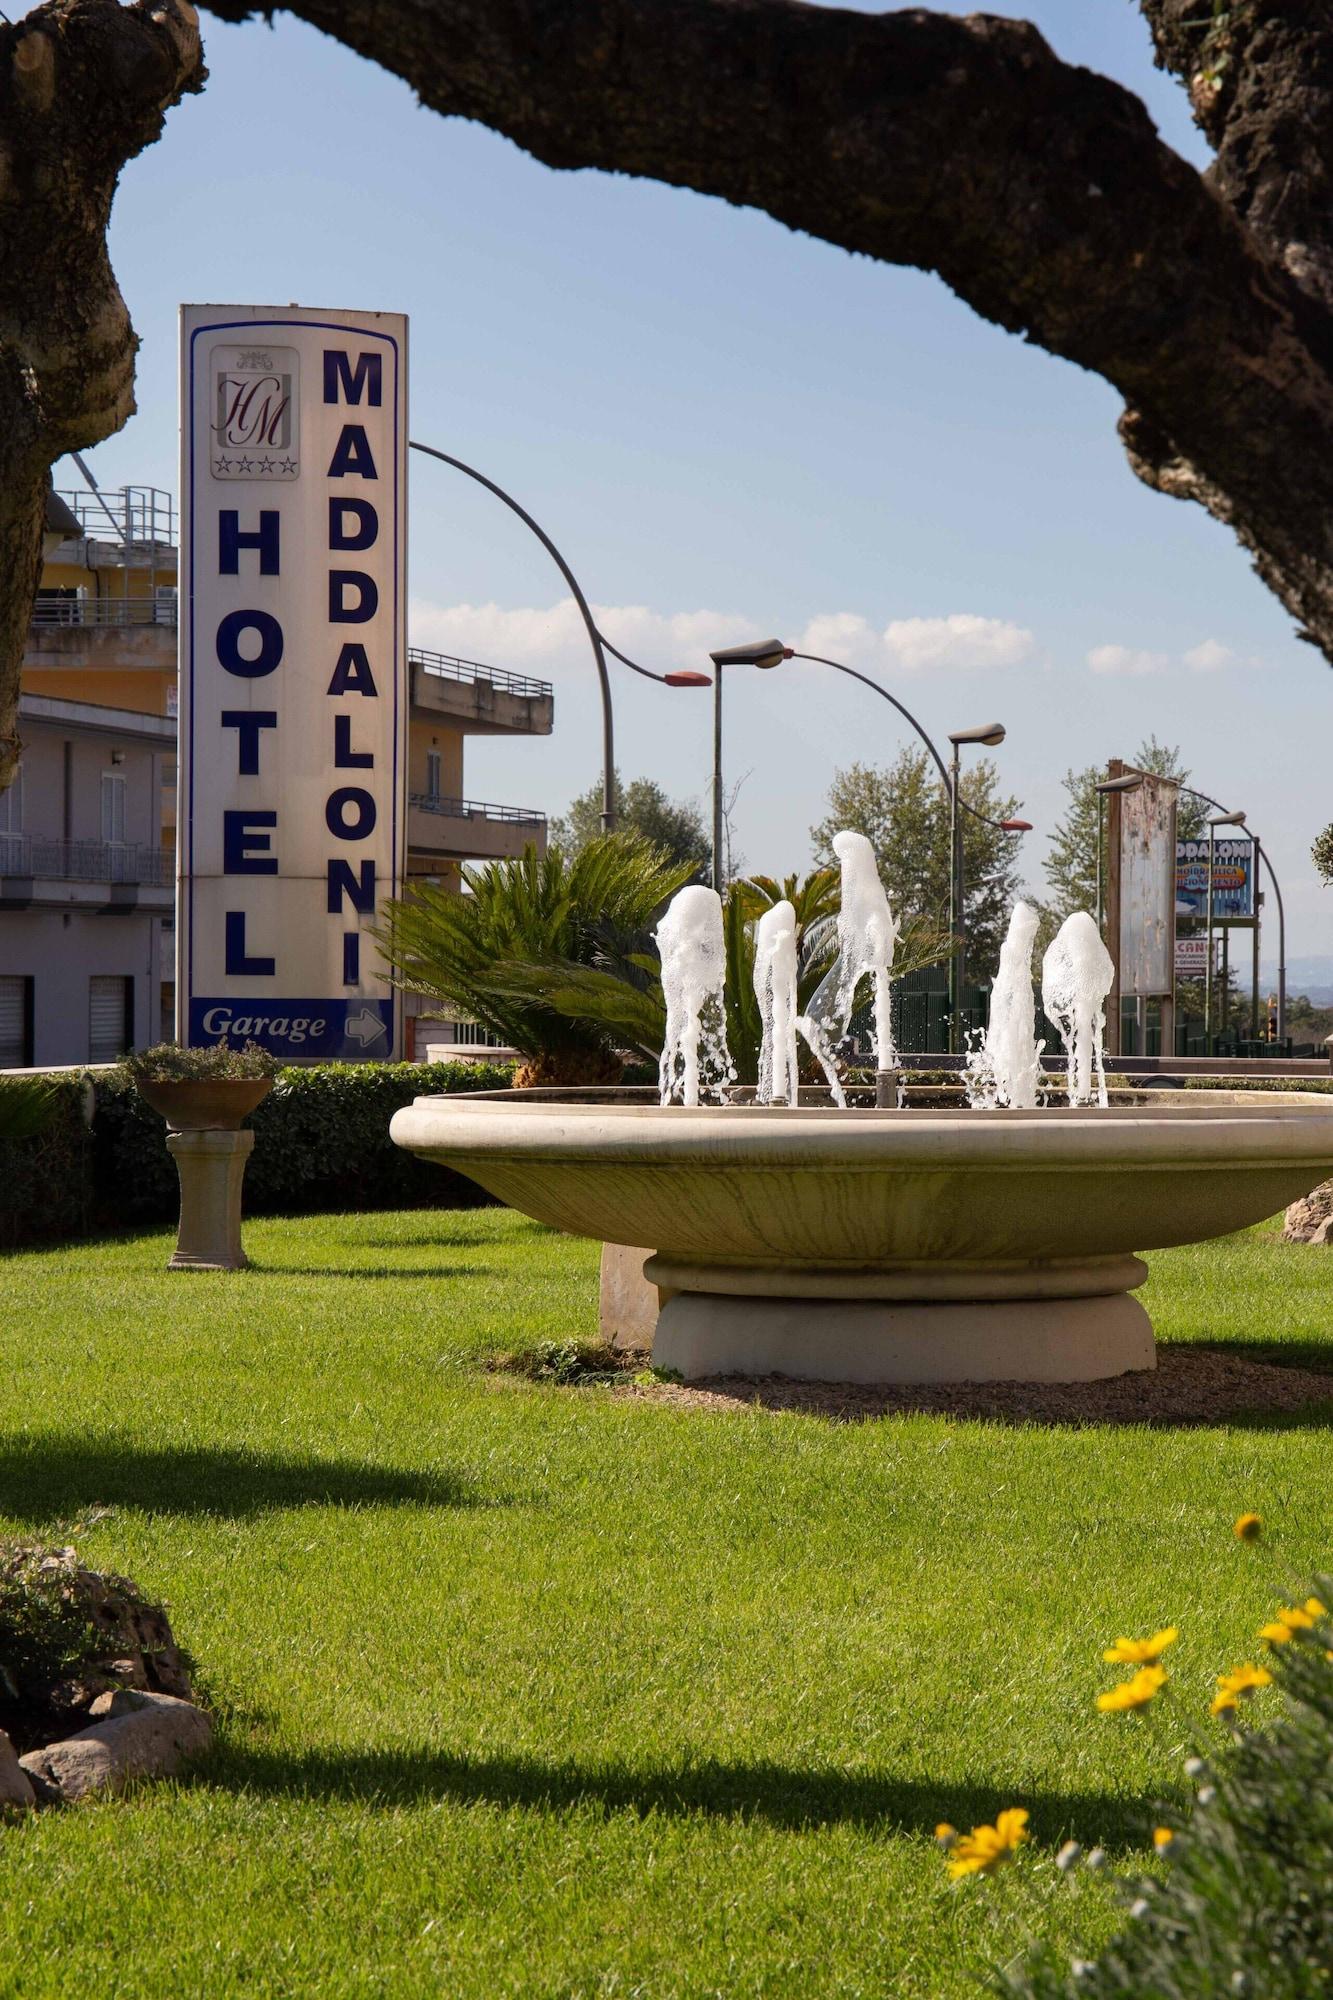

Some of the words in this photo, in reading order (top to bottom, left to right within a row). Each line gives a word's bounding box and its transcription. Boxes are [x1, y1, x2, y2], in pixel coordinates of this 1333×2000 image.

[216, 510, 284, 976] HOTEL
[323, 350, 382, 986] MADDALONI
[203, 1007, 326, 1043] Garage
